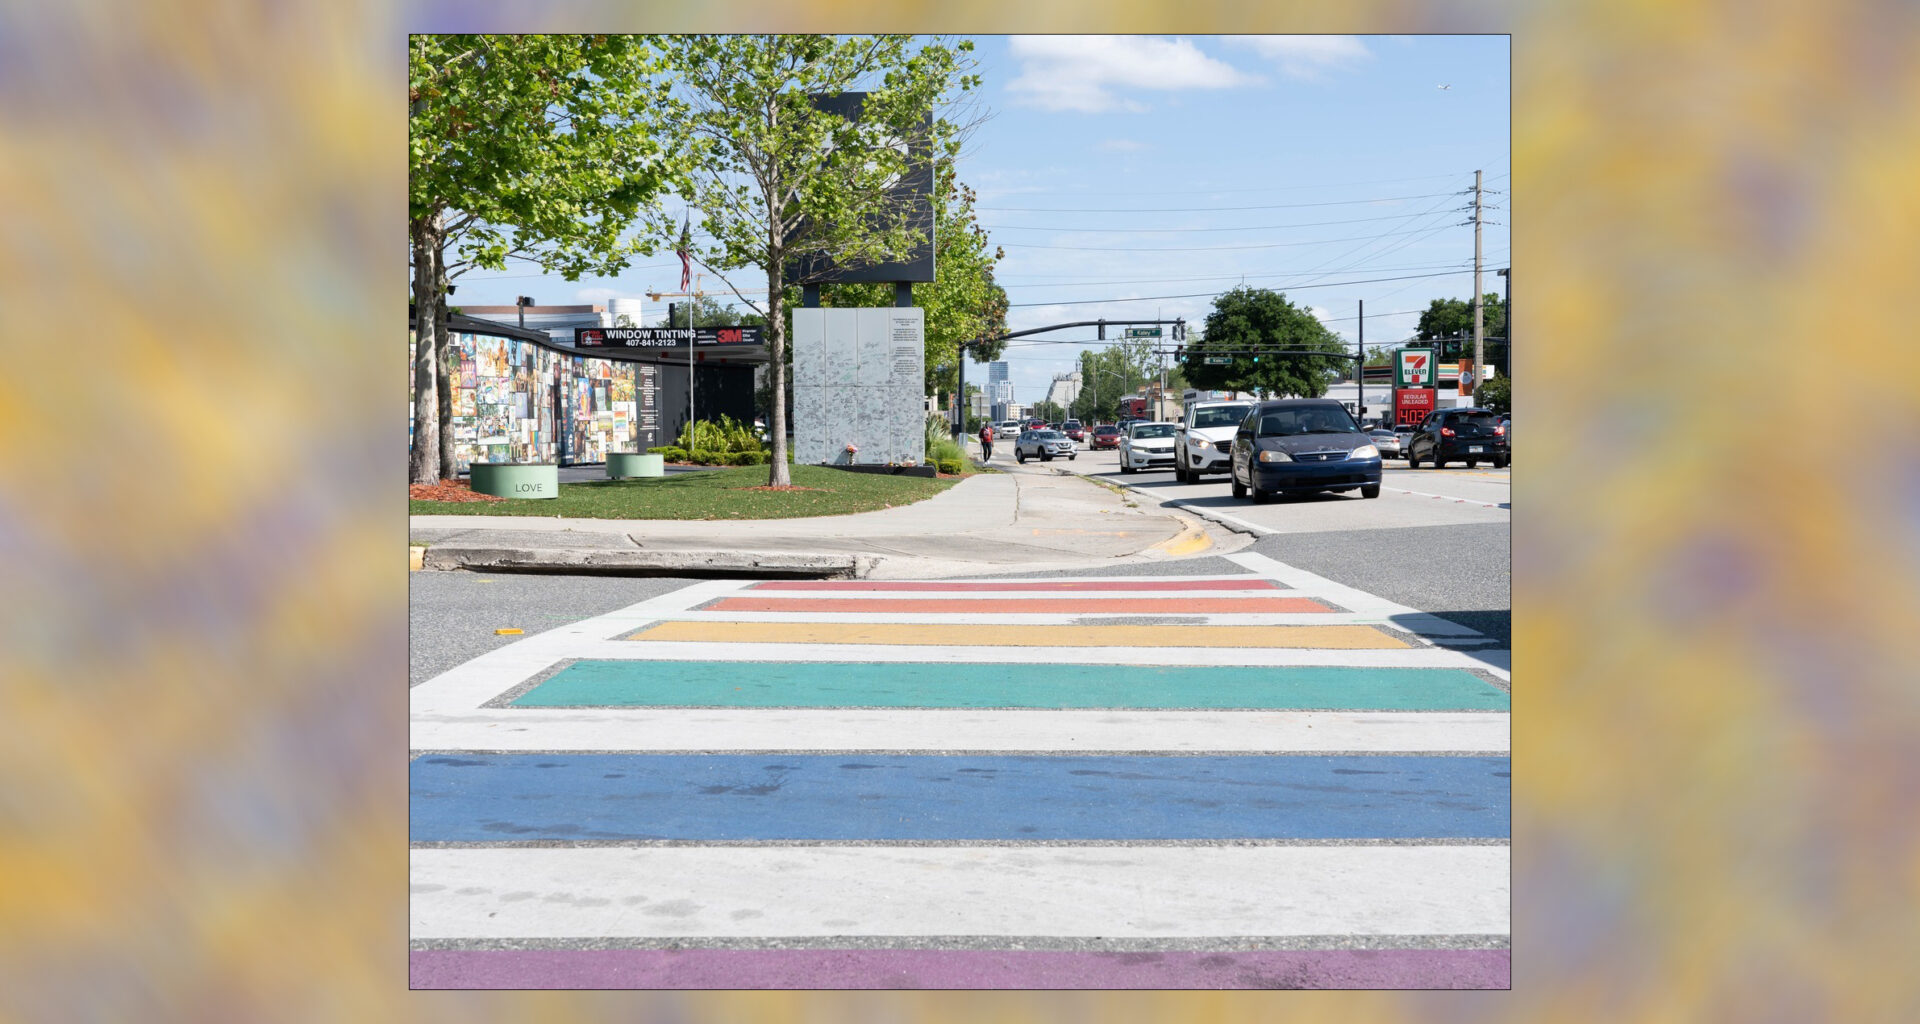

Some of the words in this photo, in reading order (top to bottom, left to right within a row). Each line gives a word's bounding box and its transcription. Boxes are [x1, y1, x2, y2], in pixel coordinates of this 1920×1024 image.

[606, 330, 649, 339] WINDOW
[654, 329, 696, 339] TINTING
[717, 329, 742, 343] 3M
[1405, 356, 1426, 383] 7
[515, 483, 543, 492] LOVE
